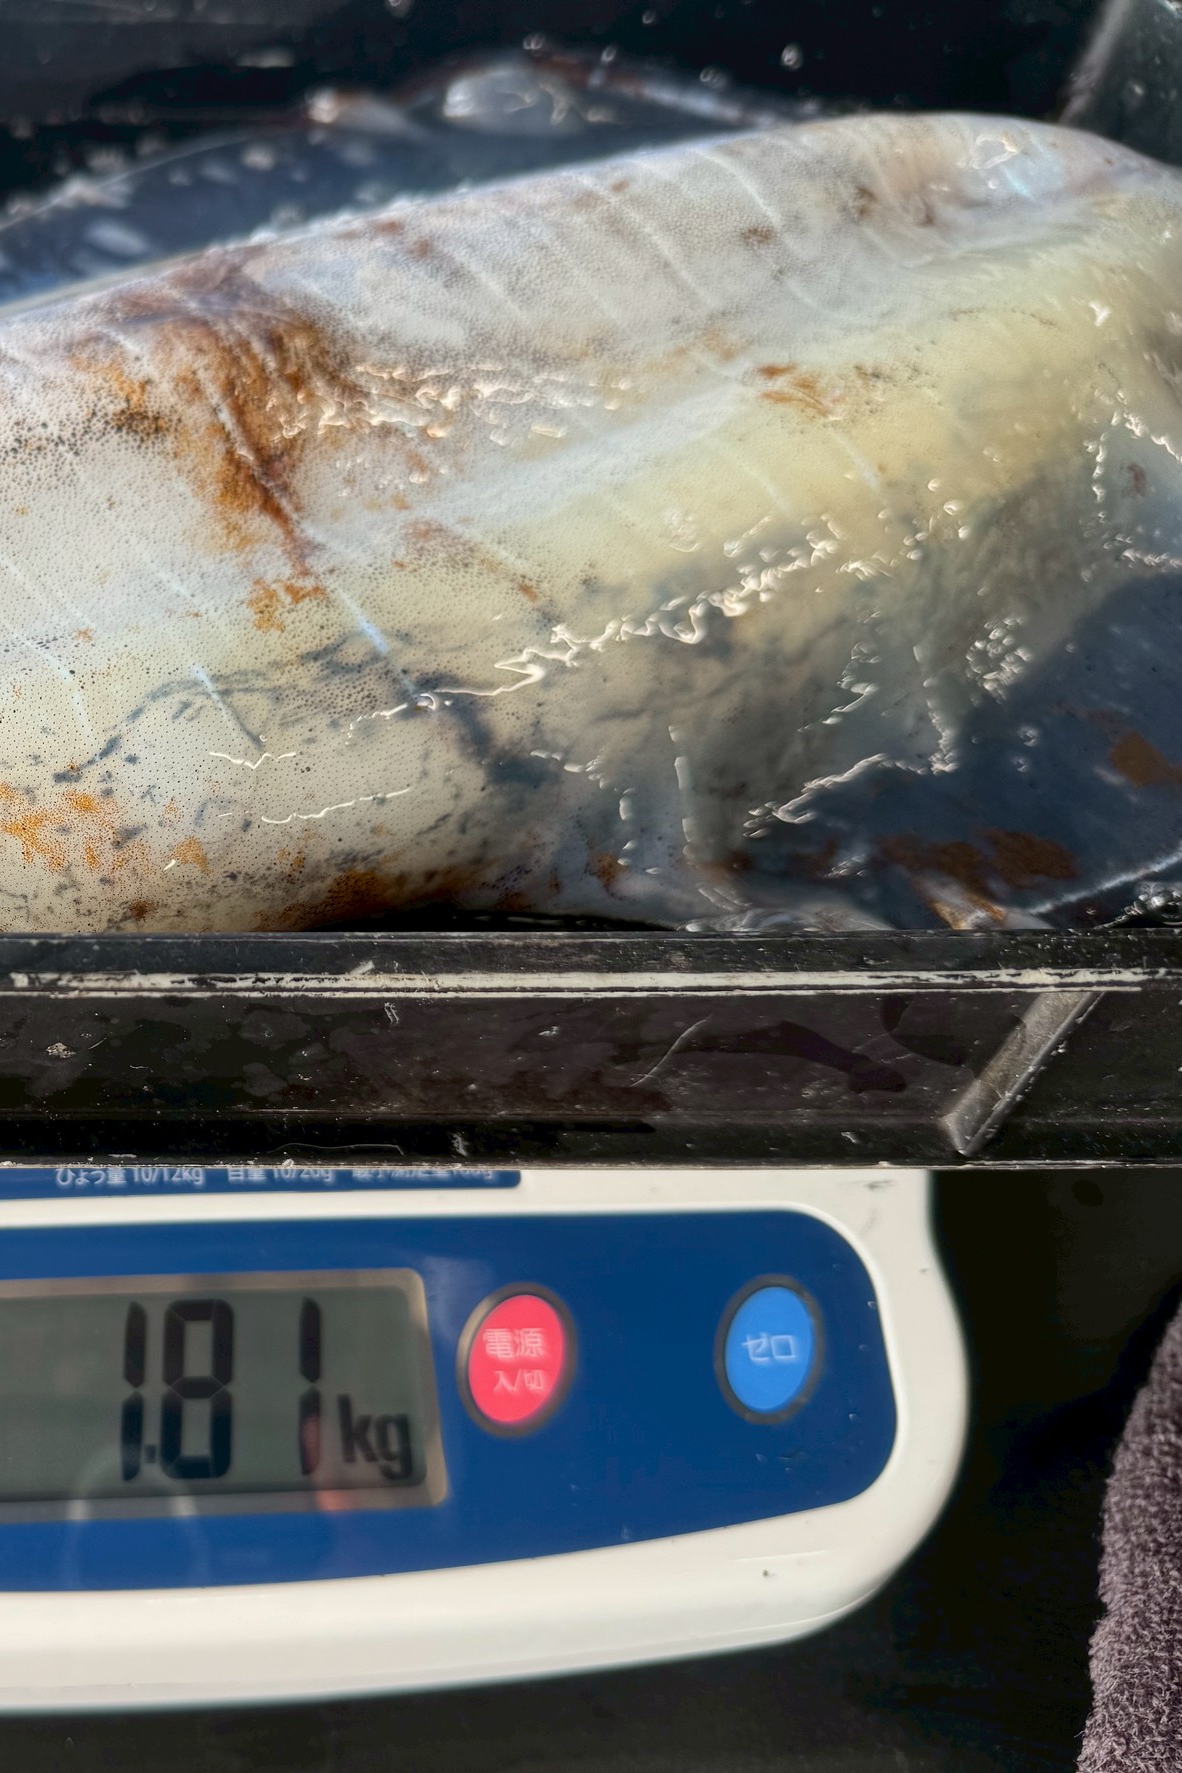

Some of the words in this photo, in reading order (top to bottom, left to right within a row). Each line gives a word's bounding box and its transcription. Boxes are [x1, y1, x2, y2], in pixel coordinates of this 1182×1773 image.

[482, 1328, 546, 1359] 電源
[741, 1332, 798, 1363] ゼロ
[121, 1296, 323, 1481] 1.81
[338, 1394, 415, 1480] kg
[492, 1369, 545, 1393] 入/切
